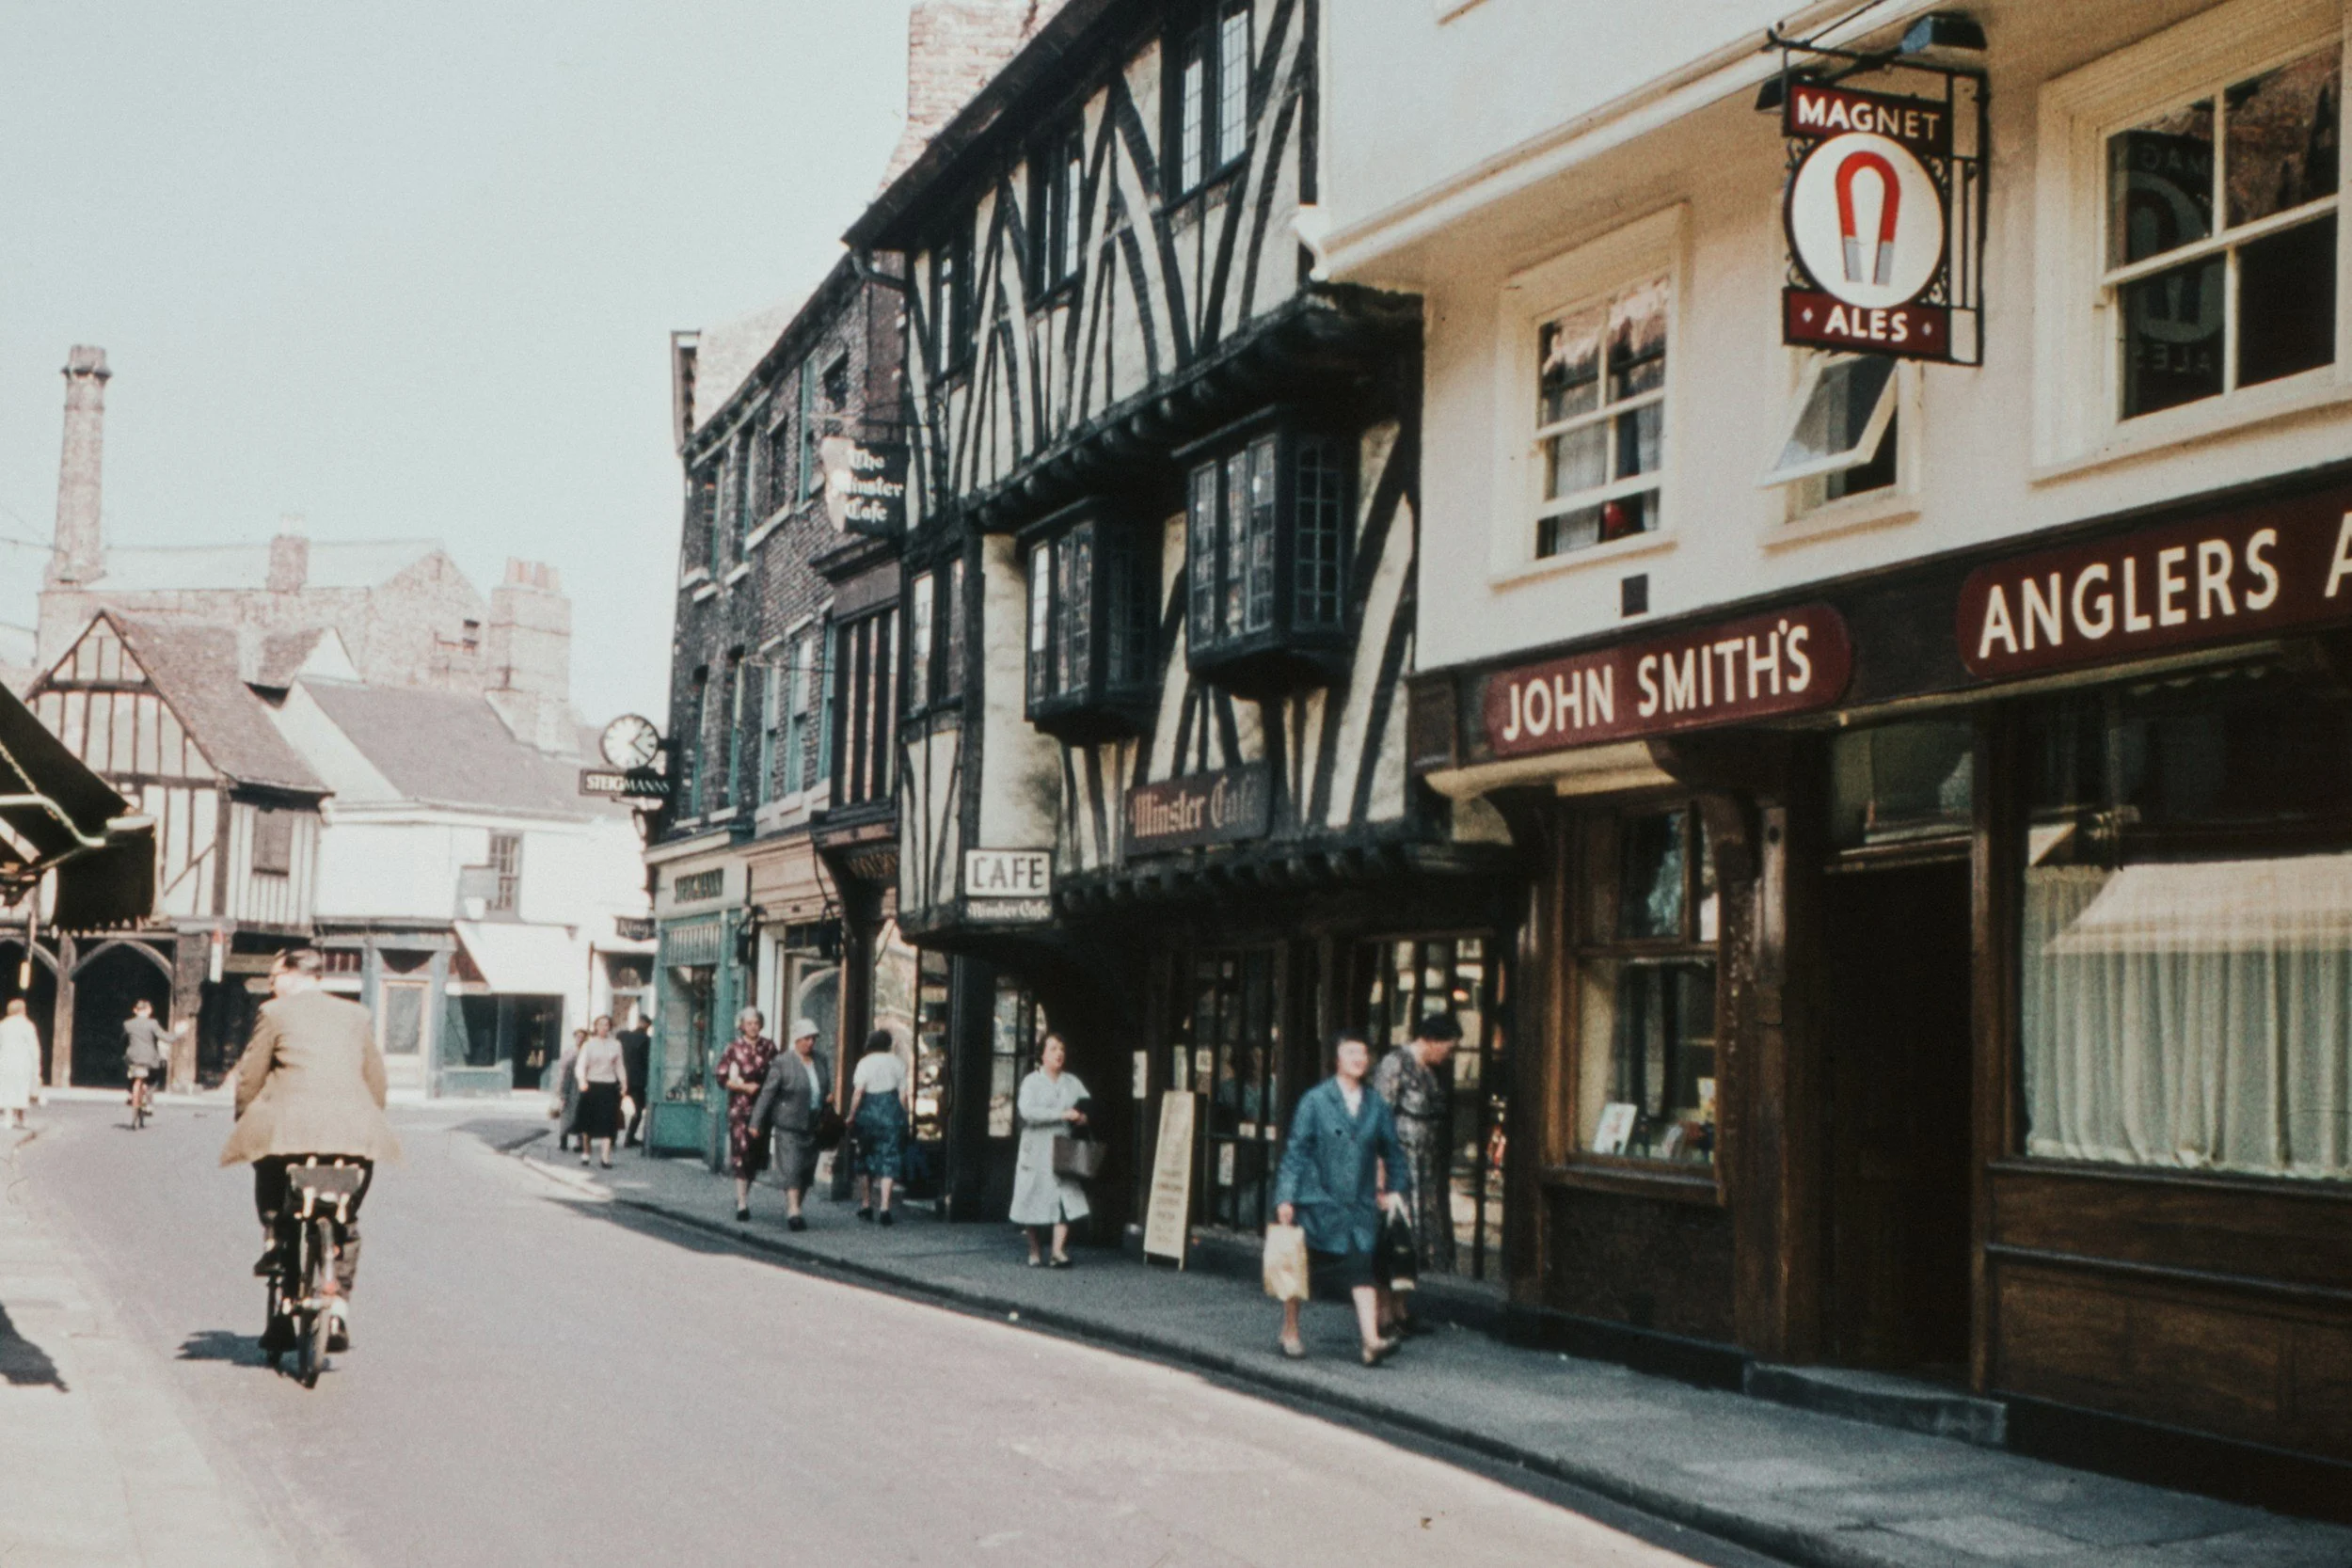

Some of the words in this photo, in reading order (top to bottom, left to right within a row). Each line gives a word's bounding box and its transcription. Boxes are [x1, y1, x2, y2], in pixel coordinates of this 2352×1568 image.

[1797, 93, 1941, 141] MAGNET
[1823, 304, 1909, 342] ALES
[848, 448, 885, 471] The
[1979, 528, 2280, 659] ANGLERS
[1502, 663, 1615, 741] JOHN
[1637, 618, 1812, 718] SMITH'S
[973, 856, 1043, 889] CAFE
